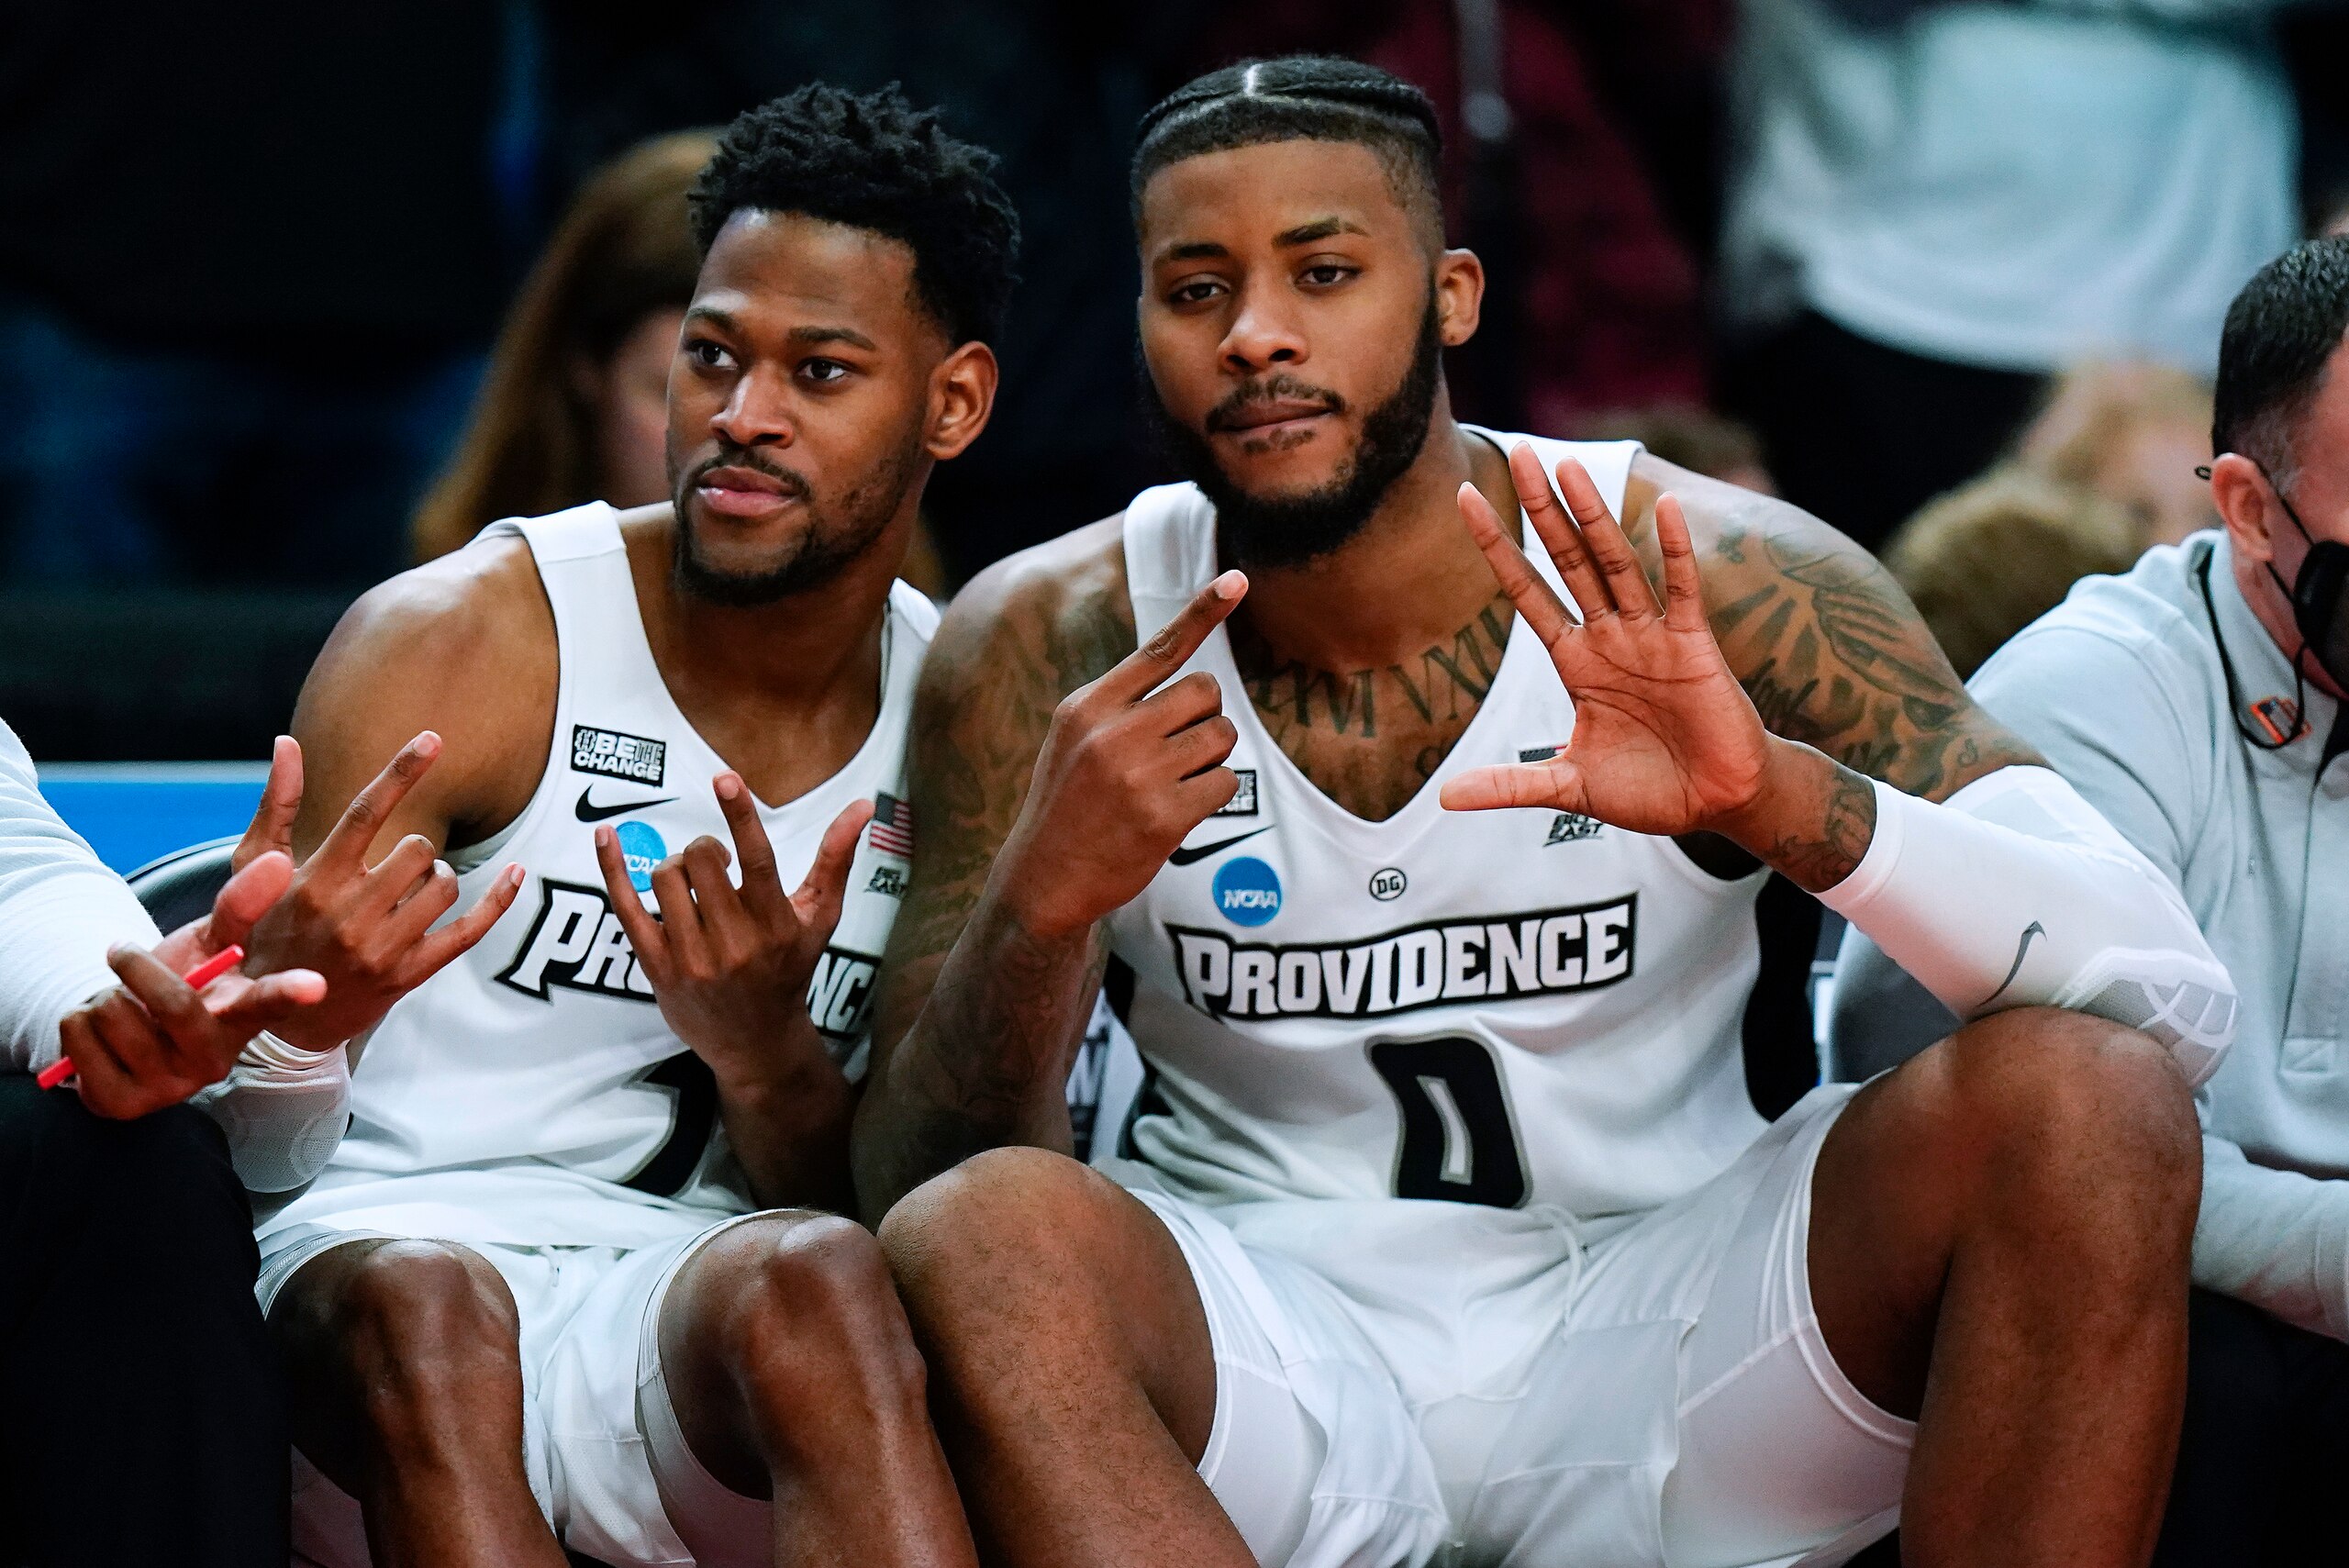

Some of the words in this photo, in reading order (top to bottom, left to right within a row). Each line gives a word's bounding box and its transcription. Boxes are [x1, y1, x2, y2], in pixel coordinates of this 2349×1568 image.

[573, 751, 662, 781] CHANGE
[623, 853, 662, 875] CA
[1376, 875, 1400, 895] DG
[1223, 888, 1279, 909] NCAA
[1169, 895, 1637, 1020] PROVIDENCE
